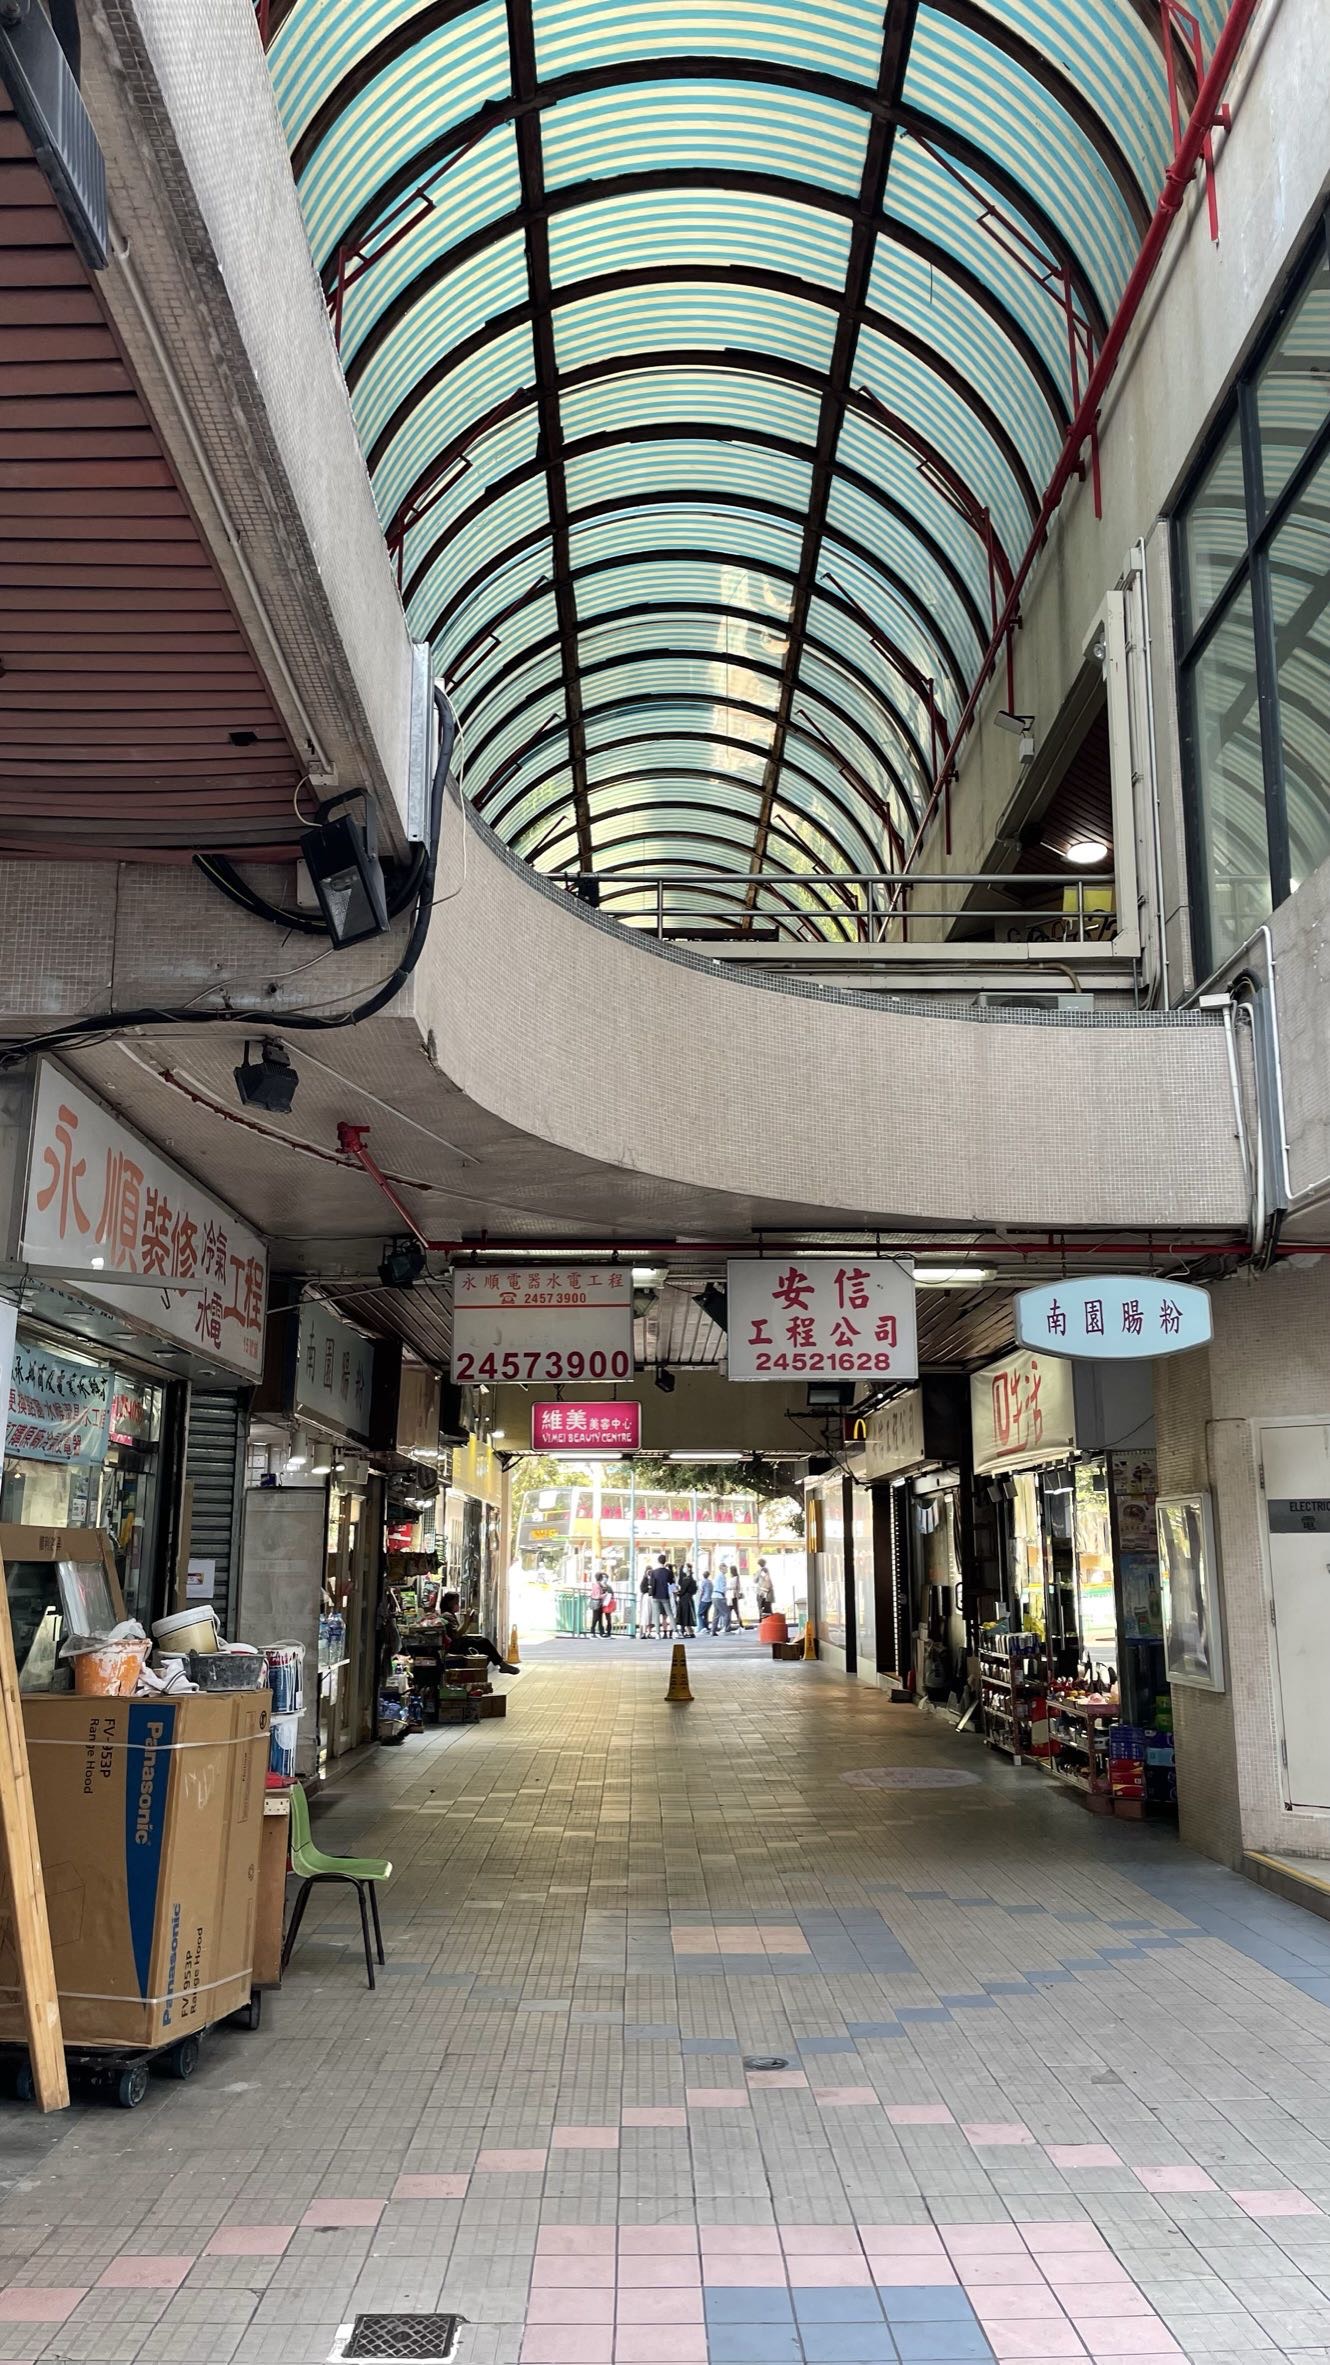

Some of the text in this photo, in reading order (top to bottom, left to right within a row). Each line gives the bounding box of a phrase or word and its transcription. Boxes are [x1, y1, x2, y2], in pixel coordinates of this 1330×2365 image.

[462, 1272, 624, 1291] 永順電器水電工程
[772, 1266, 871, 1311] 安信
[748, 1315, 898, 1348] 工程公司
[1046, 1298, 1183, 1337] 南園腸粉
[456, 1350, 629, 1380] 24573900
[756, 1353, 890, 1371] 24521628
[568, 1432, 601, 1443] BEAUTY
[602, 1432, 632, 1443] CENTRE
[83, 1760, 96, 1794] Hood
[135, 1721, 164, 1845] Panasonic
[194, 1927, 203, 1965] Hood
[162, 1903, 181, 2026] Panasonic
[181, 1950, 193, 2018] FV953P
